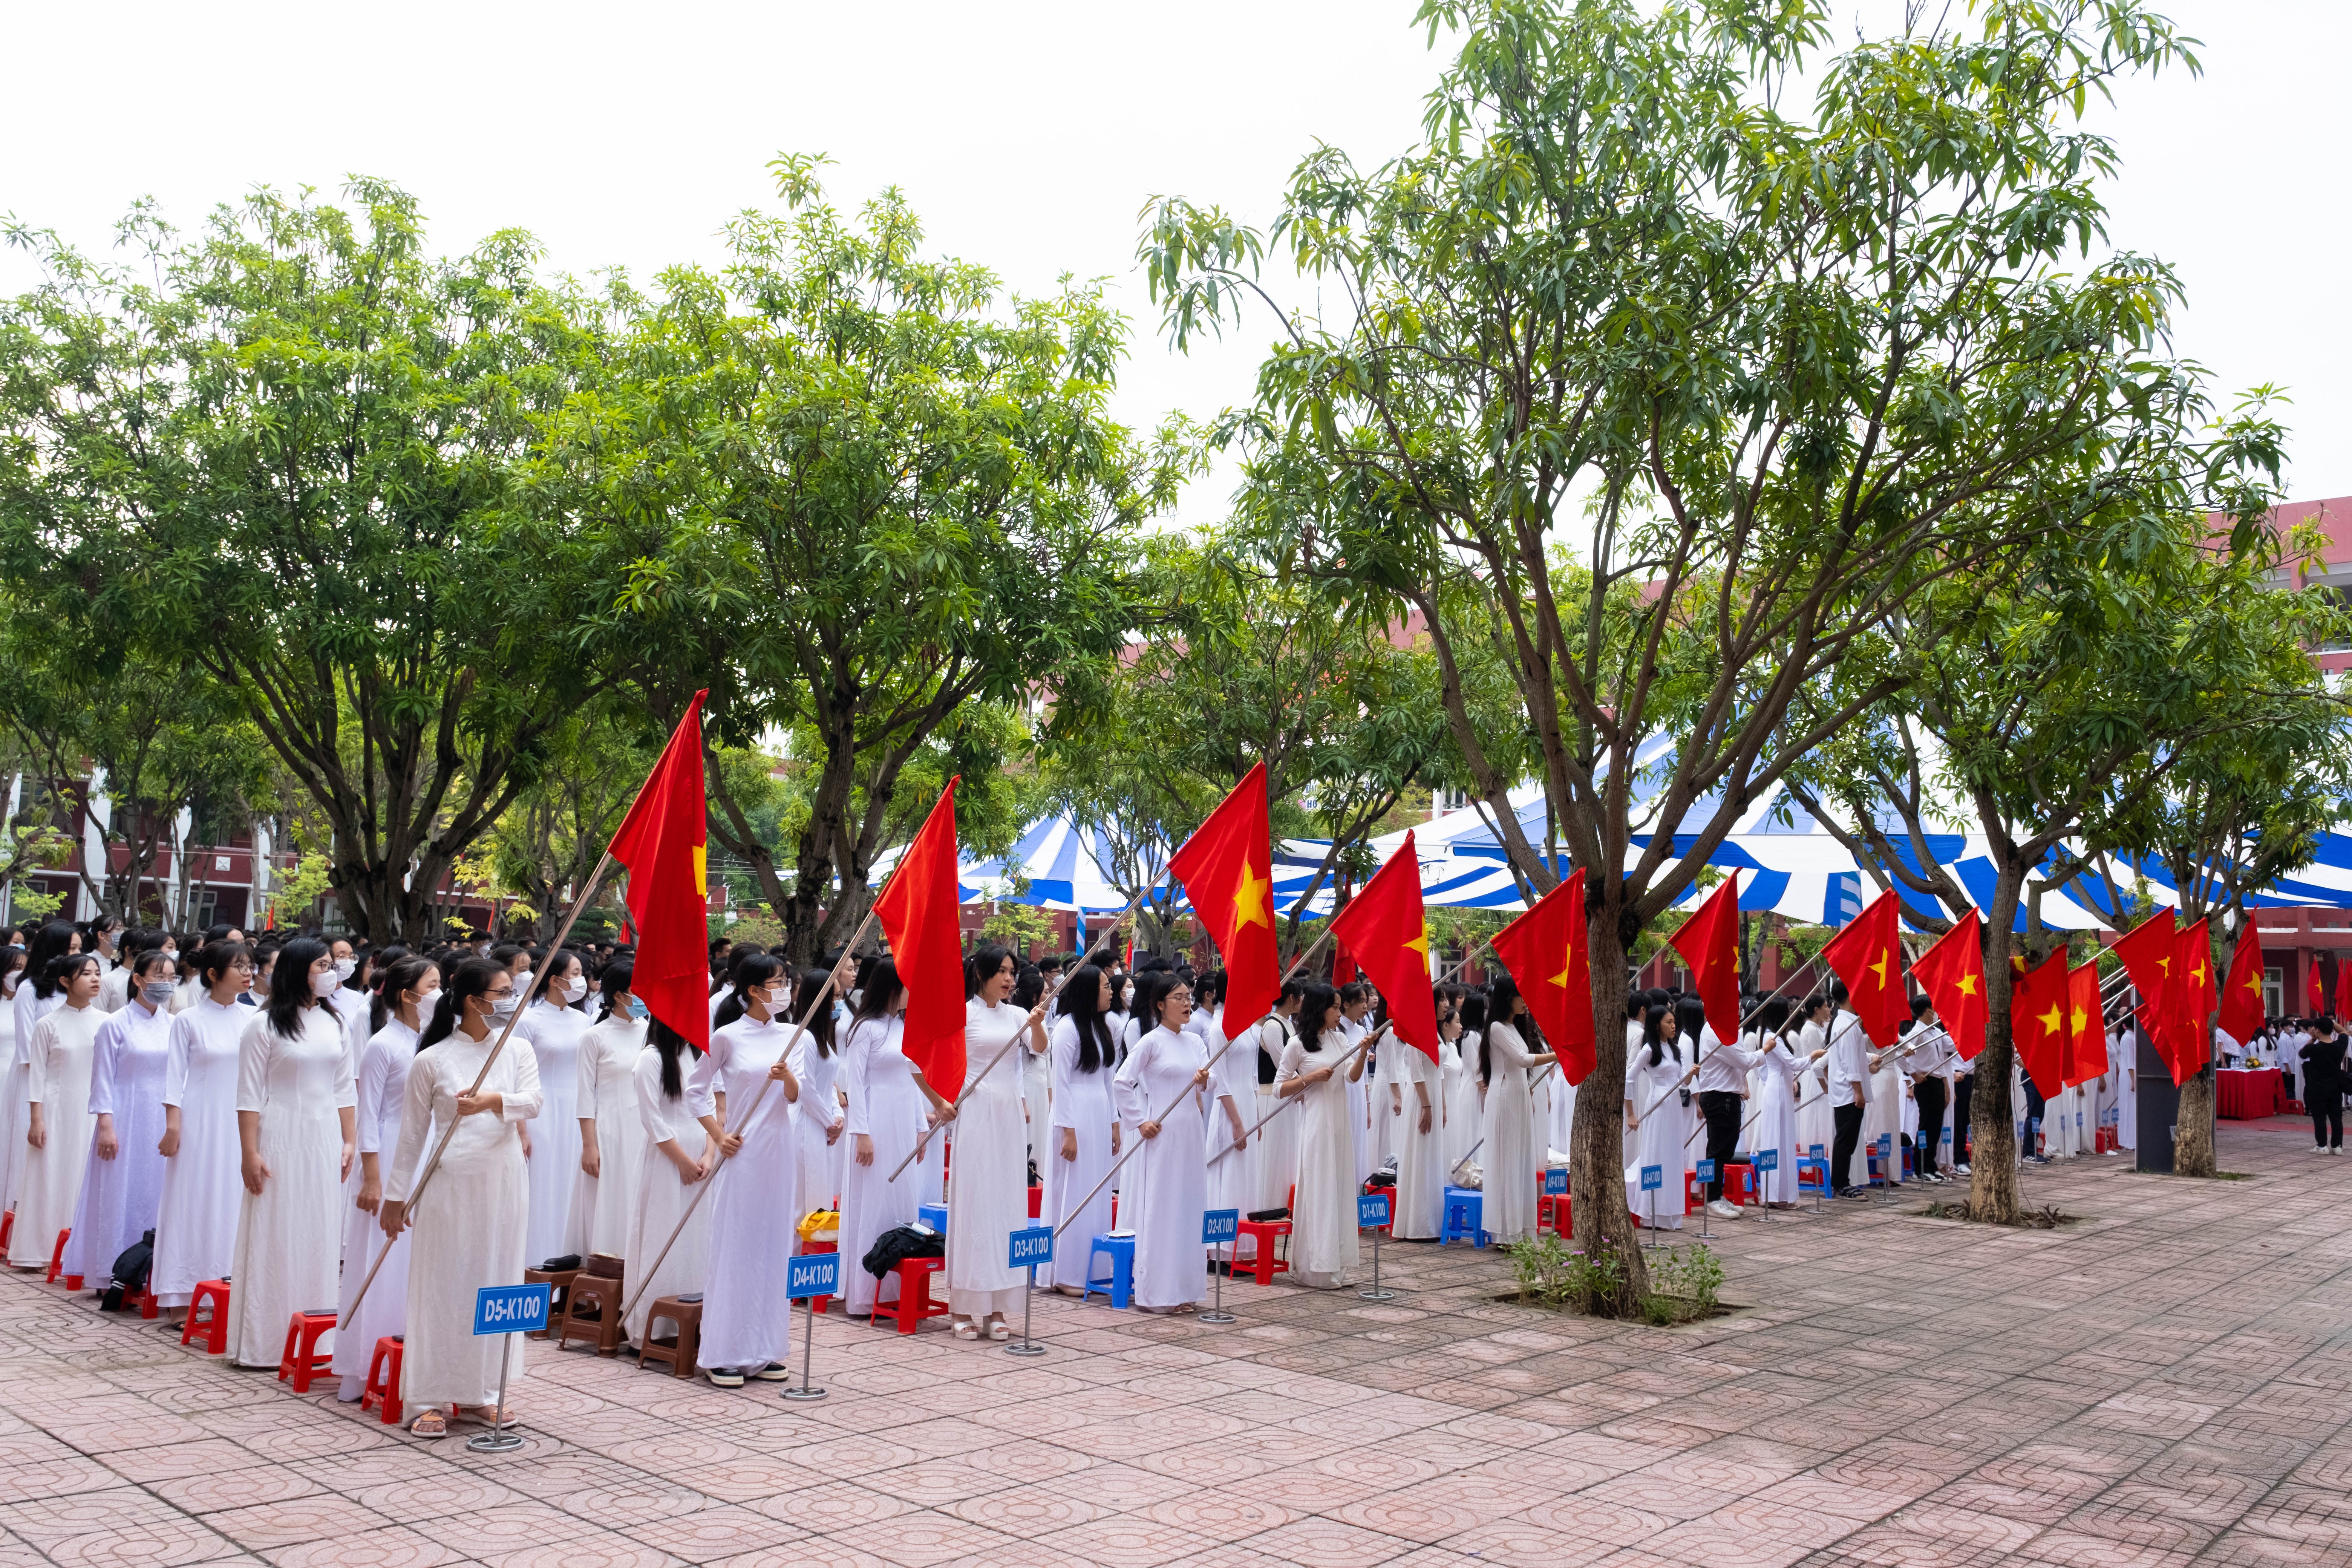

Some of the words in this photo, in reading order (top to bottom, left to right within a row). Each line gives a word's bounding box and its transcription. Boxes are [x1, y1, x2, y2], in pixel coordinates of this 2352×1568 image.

[1761, 1154, 1776, 1166] A6-K100
[1644, 1170, 1660, 1184] A8-K100
[1698, 1165, 1713, 1177] A7-K100
[1548, 1175, 1565, 1188] A9-K100
[1362, 1202, 1385, 1218] D1-K100
[1207, 1217, 1234, 1234] D2-K100
[1015, 1236, 1048, 1257] D3-K100
[793, 1264, 833, 1287] D4-K100
[485, 1296, 540, 1321] D5-K100
